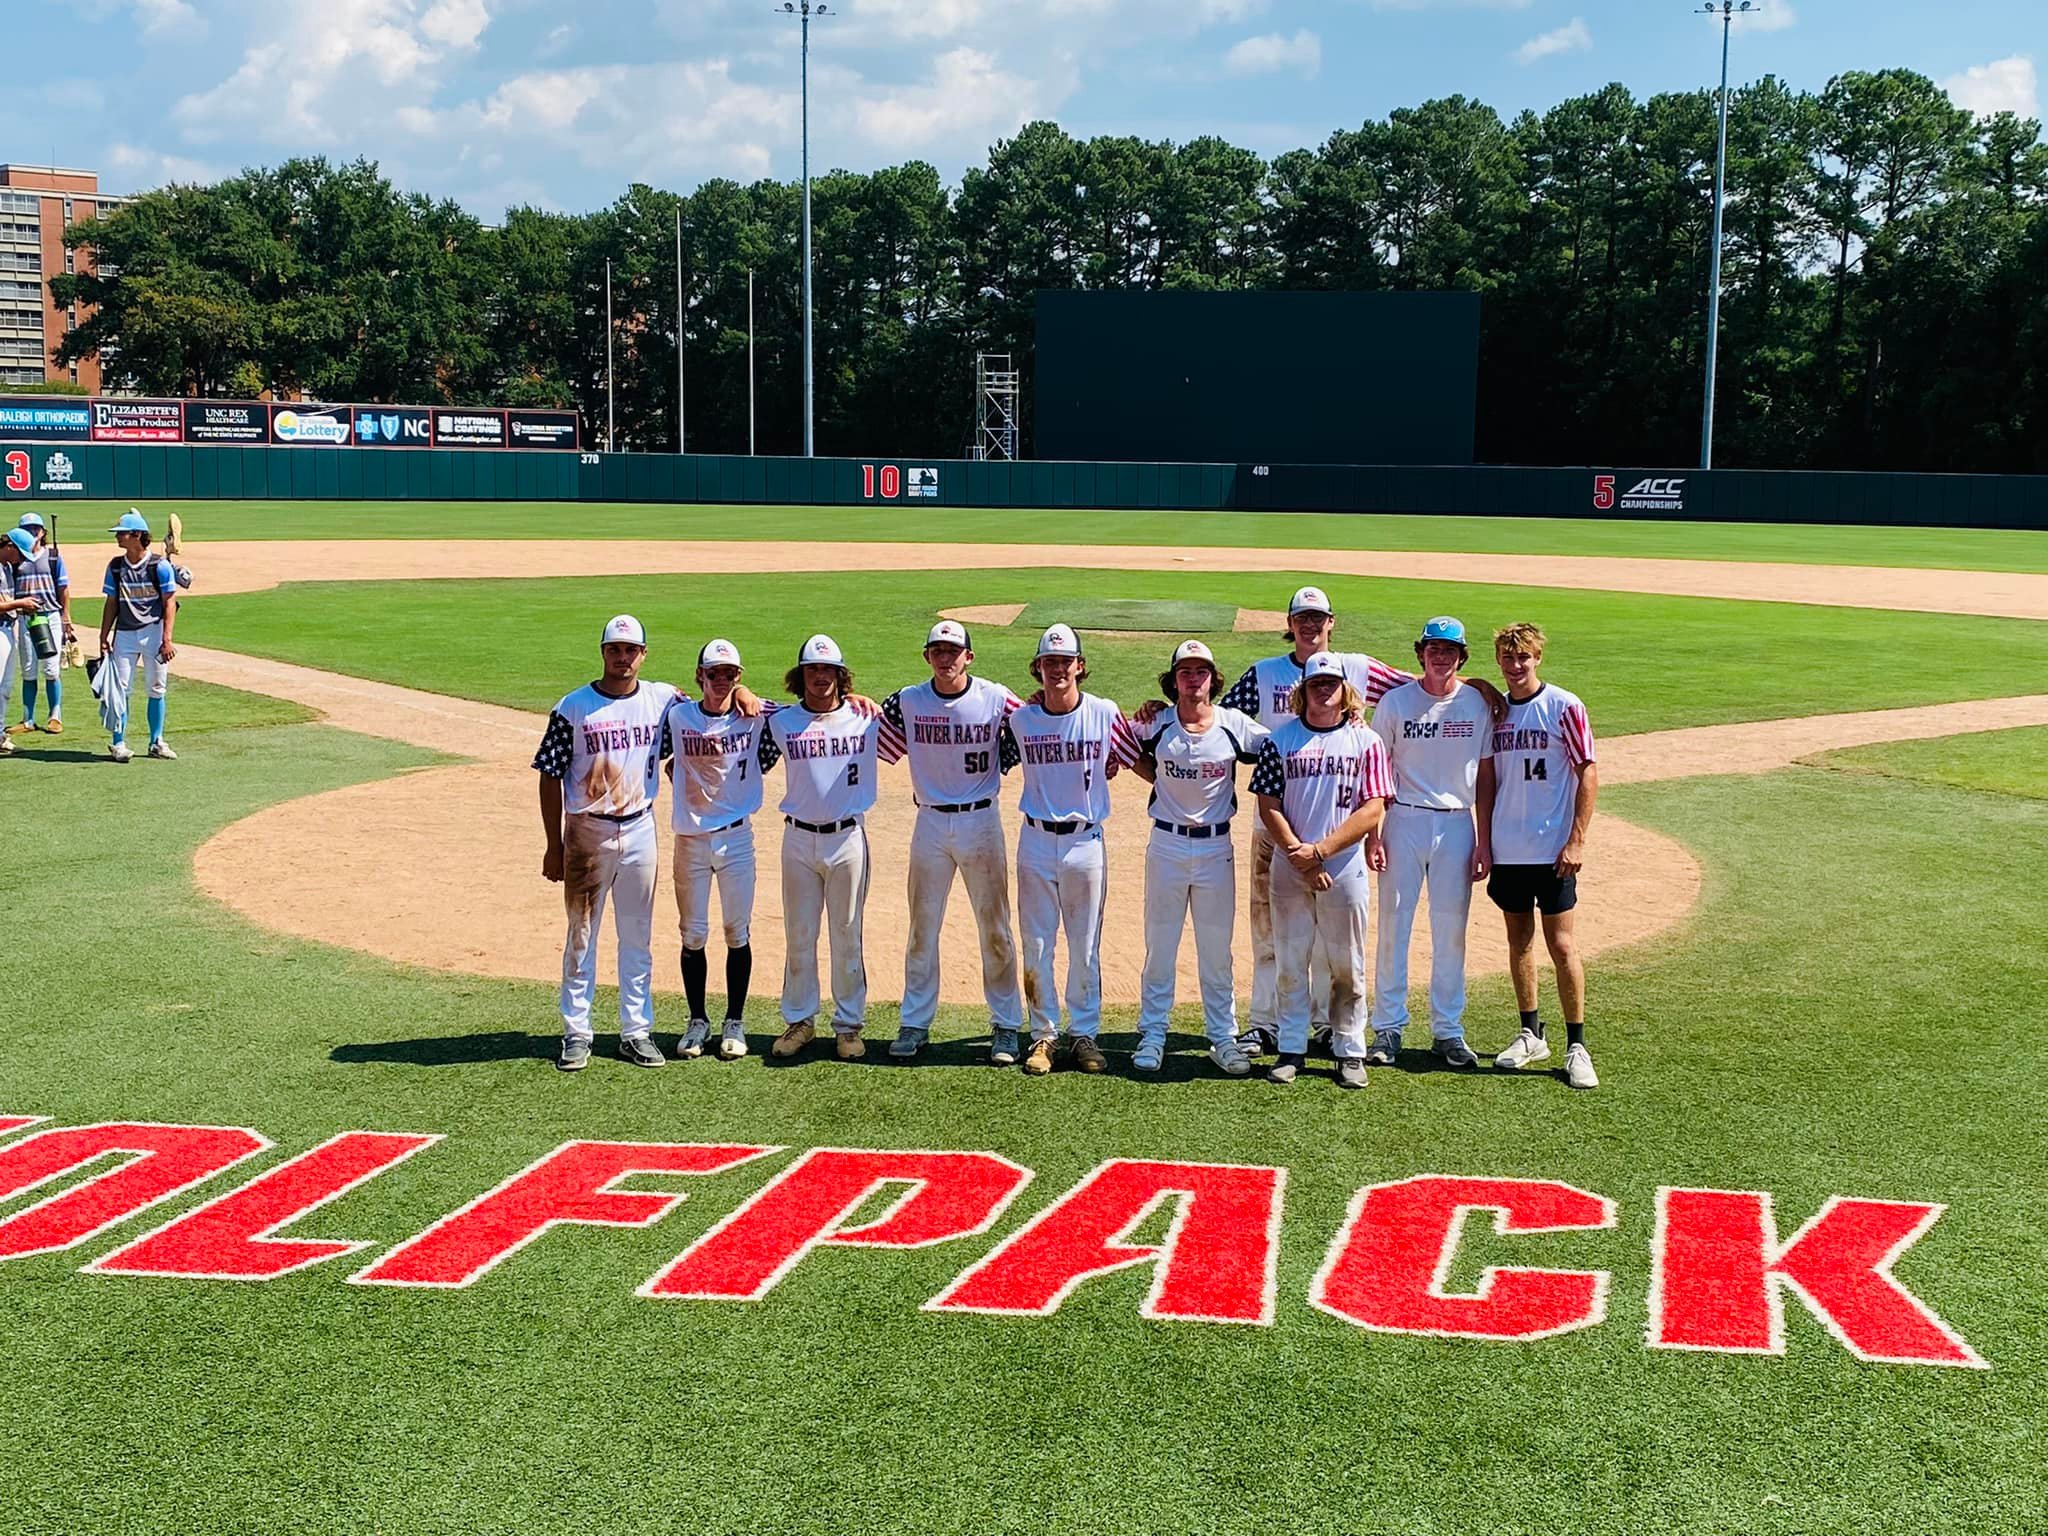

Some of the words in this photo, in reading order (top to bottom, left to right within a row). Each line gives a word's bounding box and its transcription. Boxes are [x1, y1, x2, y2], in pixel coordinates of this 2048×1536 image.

[0, 411, 33, 423] RALEIGH
[34, 412, 88, 424] ORTHOPAEDIC
[94, 404, 179, 427] ELIZABETH'S
[112, 417, 139, 427] Pecan
[140, 417, 179, 427] Products
[205, 408, 228, 417] UNC
[229, 409, 249, 418] REX
[454, 416, 500, 425] NATIONAL
[300, 424, 345, 438] Lottery
[404, 419, 430, 437] NC
[454, 425, 501, 434] COATINGS
[580, 454, 600, 464] 370
[5, 450, 31, 491] 3
[862, 465, 900, 498] 10
[1252, 465, 1269, 476] 400
[1593, 475, 1615, 509] 5
[1627, 479, 1686, 494] ACC
[1620, 500, 1683, 509] CHAMPIONSHIPS
[584, 729, 630, 755] RIVER
[633, 724, 659, 747] RAT
[914, 723, 952, 744] RIVER
[953, 723, 991, 744] RATS
[1515, 729, 1549, 751] RATS
[786, 739, 827, 760] RIVER
[831, 735, 865, 756] RATS
[1024, 742, 1064, 764] RIVER
[1066, 740, 1102, 762] RATS
[737, 758, 748, 781] 7
[964, 750, 990, 774] 50
[1524, 758, 1547, 781] 14
[847, 763, 859, 786] 2
[1336, 783, 1353, 808] 12
[0, 1115, 1990, 1370] OLFPACK
